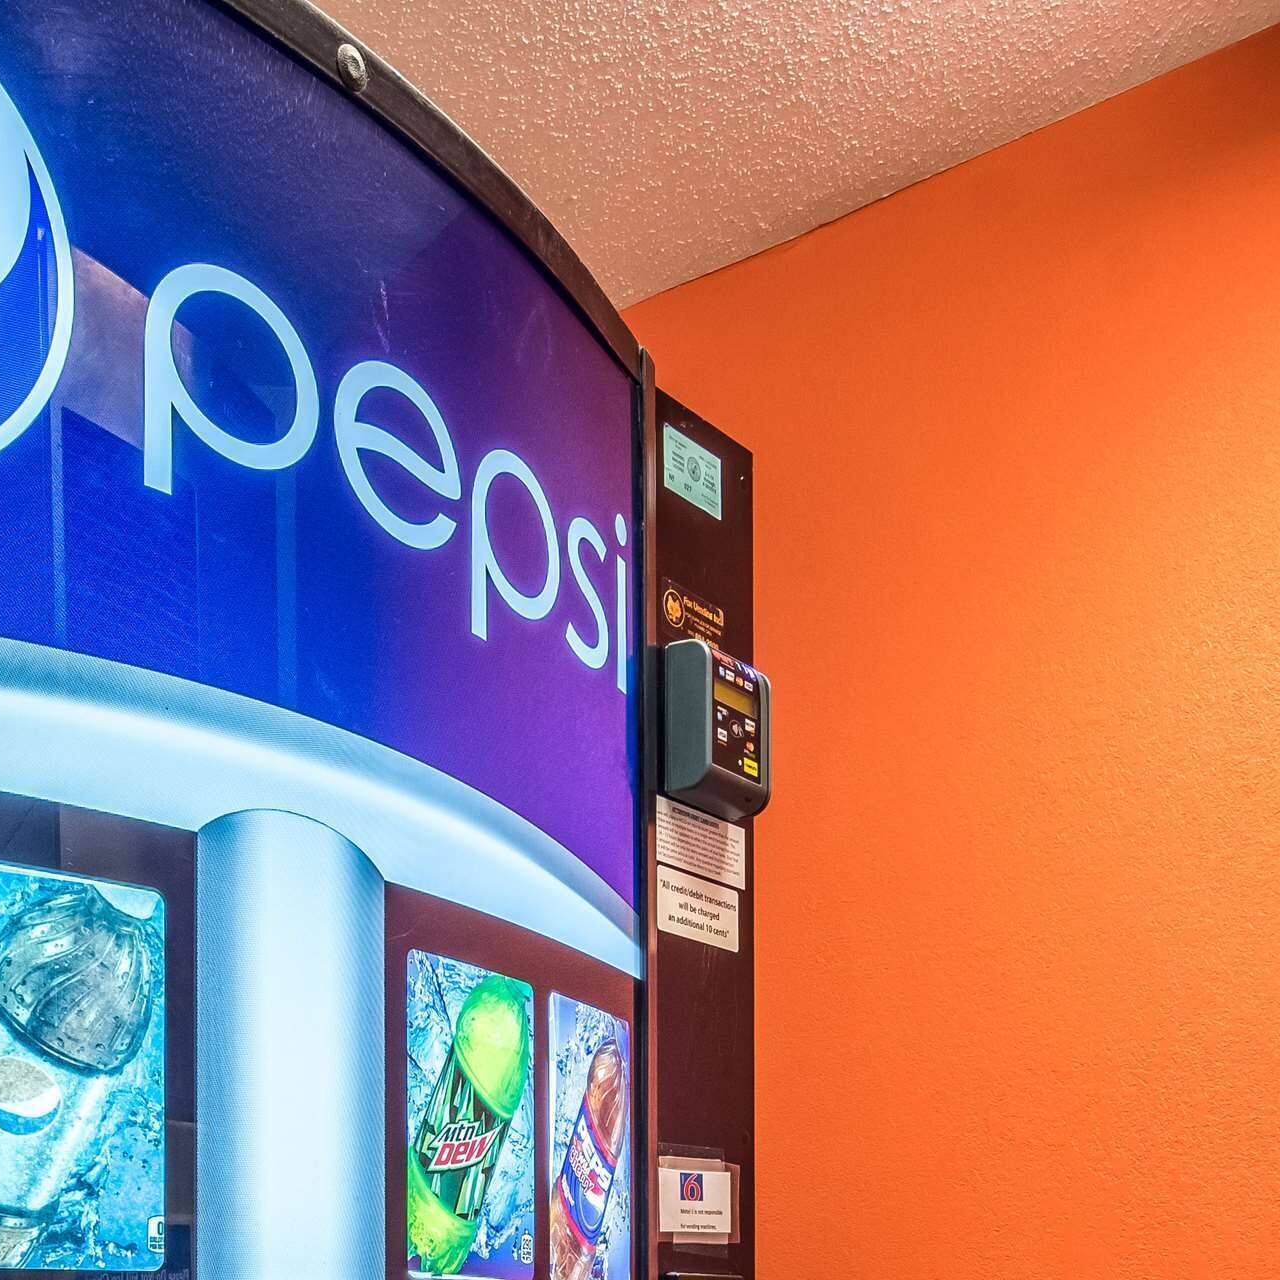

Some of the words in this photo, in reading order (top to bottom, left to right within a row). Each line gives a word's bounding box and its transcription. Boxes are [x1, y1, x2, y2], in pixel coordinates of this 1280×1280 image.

[143, 263, 628, 694] pepsi
[670, 882, 704, 902] credit/debit
[704, 894, 736, 912] transactions
[678, 901, 688, 912] will
[689, 904, 697, 914] be
[698, 907, 720, 921] charged
[668, 914, 676, 922] an
[676, 916, 704, 931] additional
[706, 924, 713, 934] 10
[438, 1124, 476, 1142] Mtn
